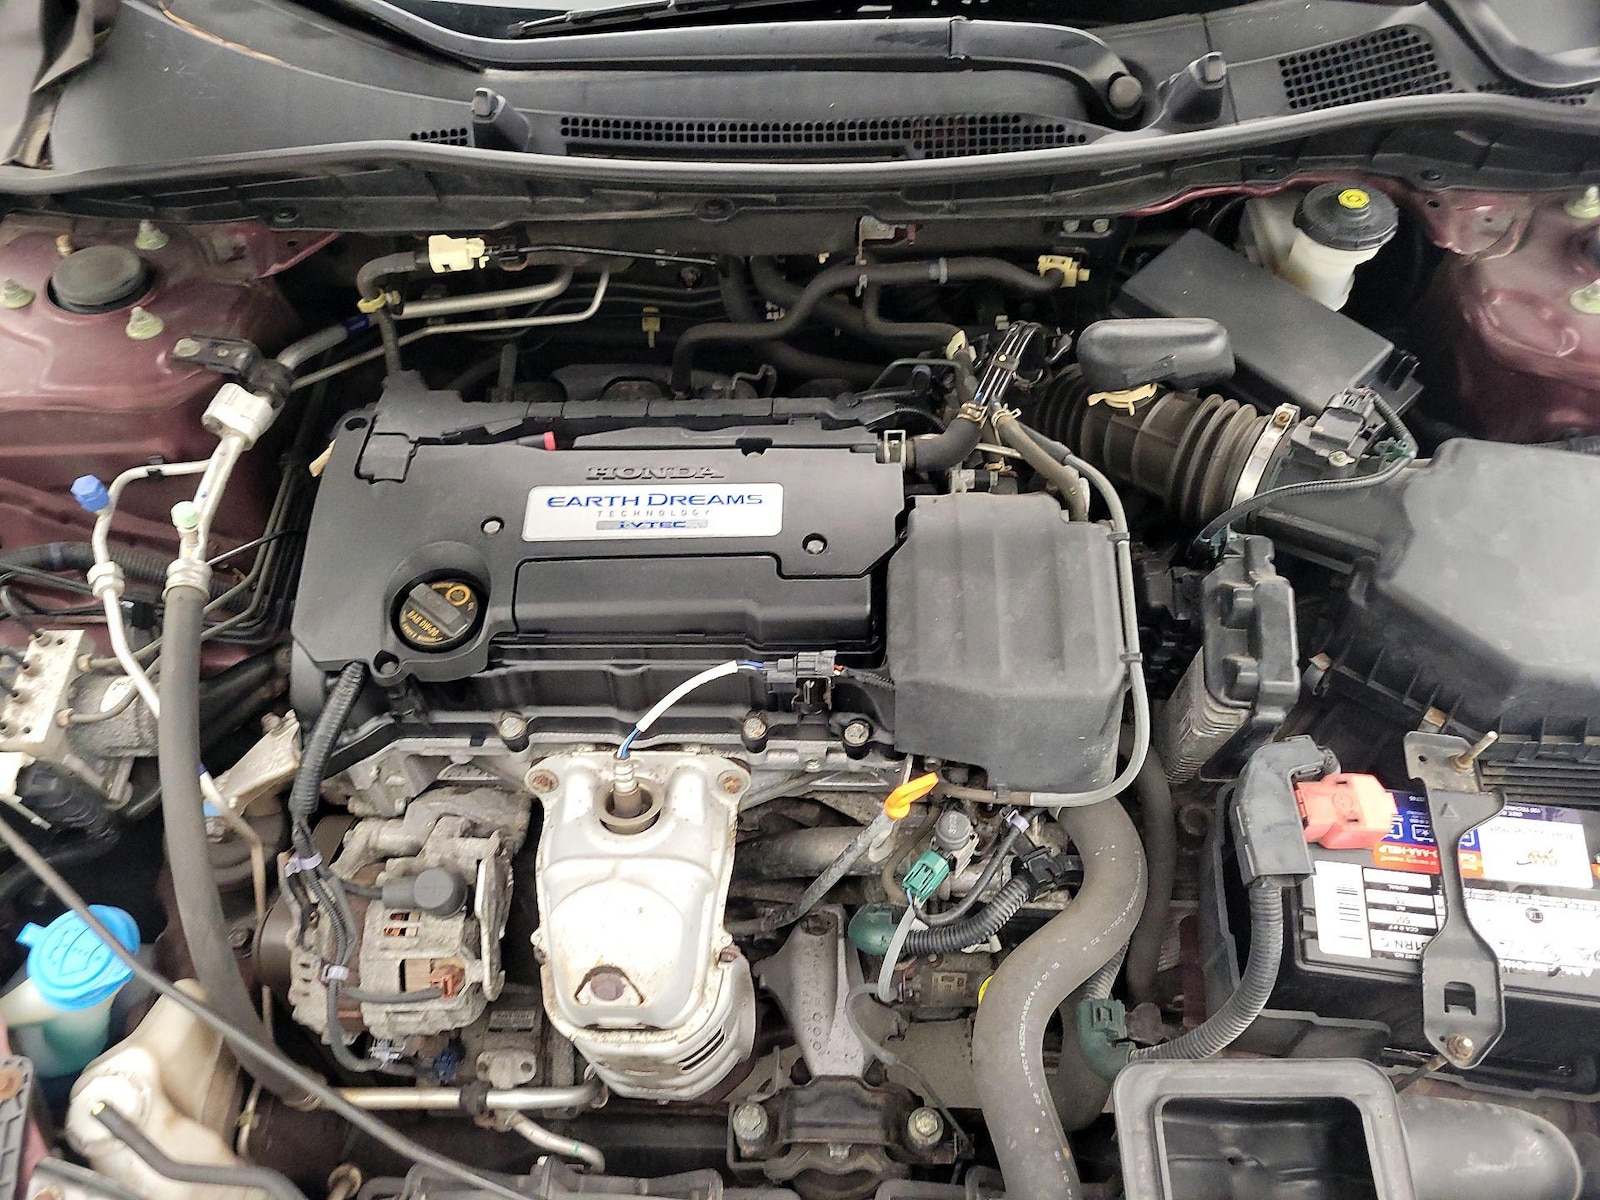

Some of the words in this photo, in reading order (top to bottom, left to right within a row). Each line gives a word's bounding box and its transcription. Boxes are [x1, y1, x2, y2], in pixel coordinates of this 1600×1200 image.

[586, 467, 724, 480] HONDA
[547, 496, 640, 508] EARTH
[647, 493, 763, 507] DREAMS
[597, 510, 711, 518] TECHNOLOGY
